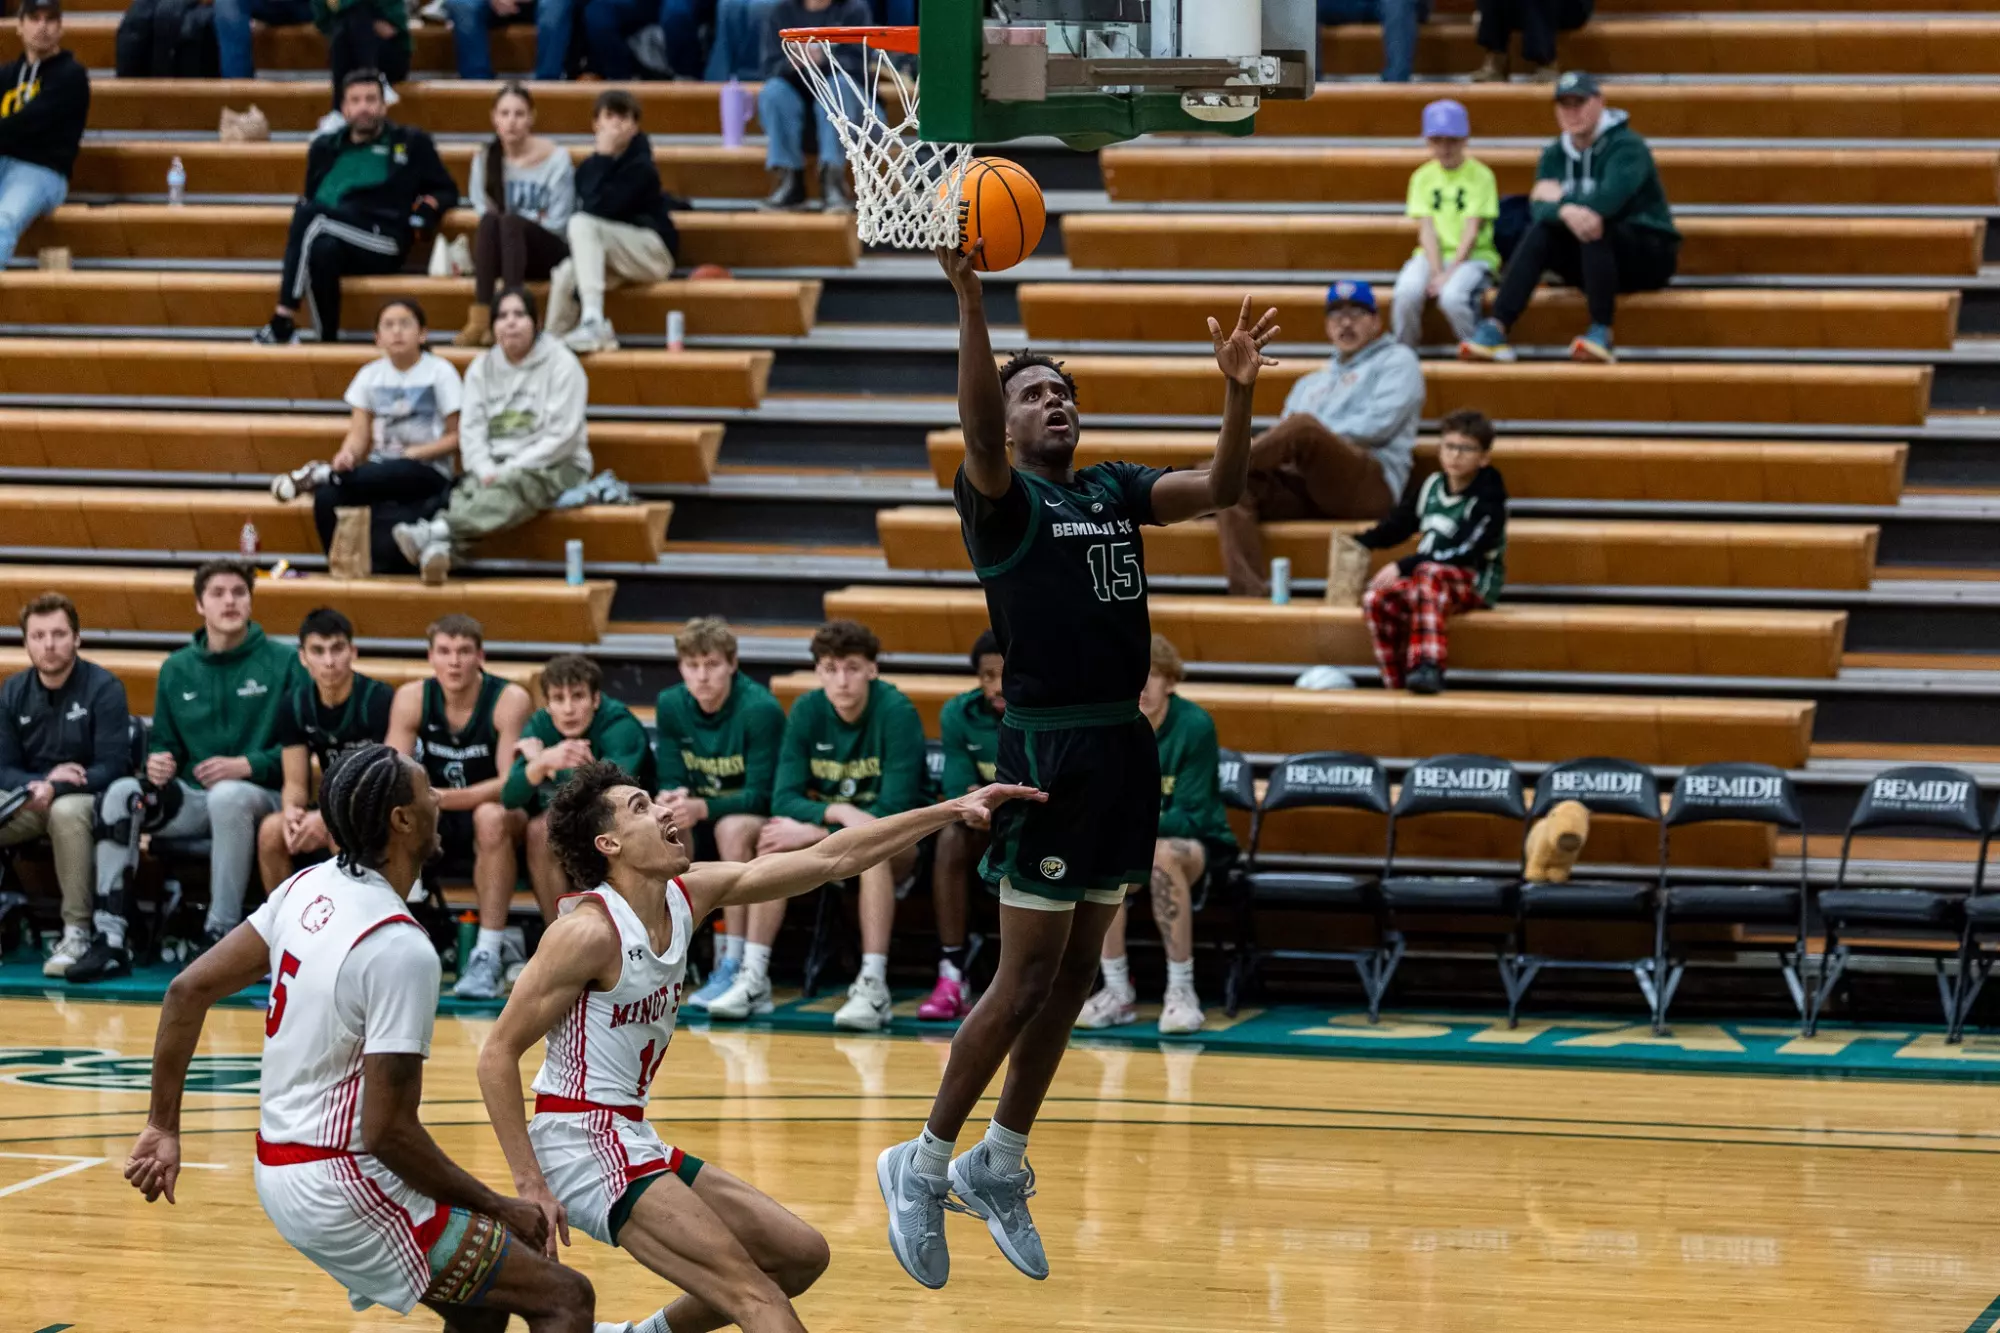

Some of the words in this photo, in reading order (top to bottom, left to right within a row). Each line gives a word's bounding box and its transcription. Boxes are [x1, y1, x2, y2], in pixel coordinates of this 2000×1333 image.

[1052, 520, 1116, 538] BEMIDJI
[1086, 542, 1143, 602] 15
[1285, 764, 1375, 787] BEMIDJI
[1413, 766, 1512, 791] BEMIDJI
[1551, 770, 1644, 794] BEMIDJI
[1684, 775, 1783, 799] BEMIDJI
[1872, 778, 1970, 804] BEMIDJI
[265, 948, 302, 1039] 5
[609, 985, 669, 1029] MINOT
[1289, 1012, 2000, 1062] STATE
